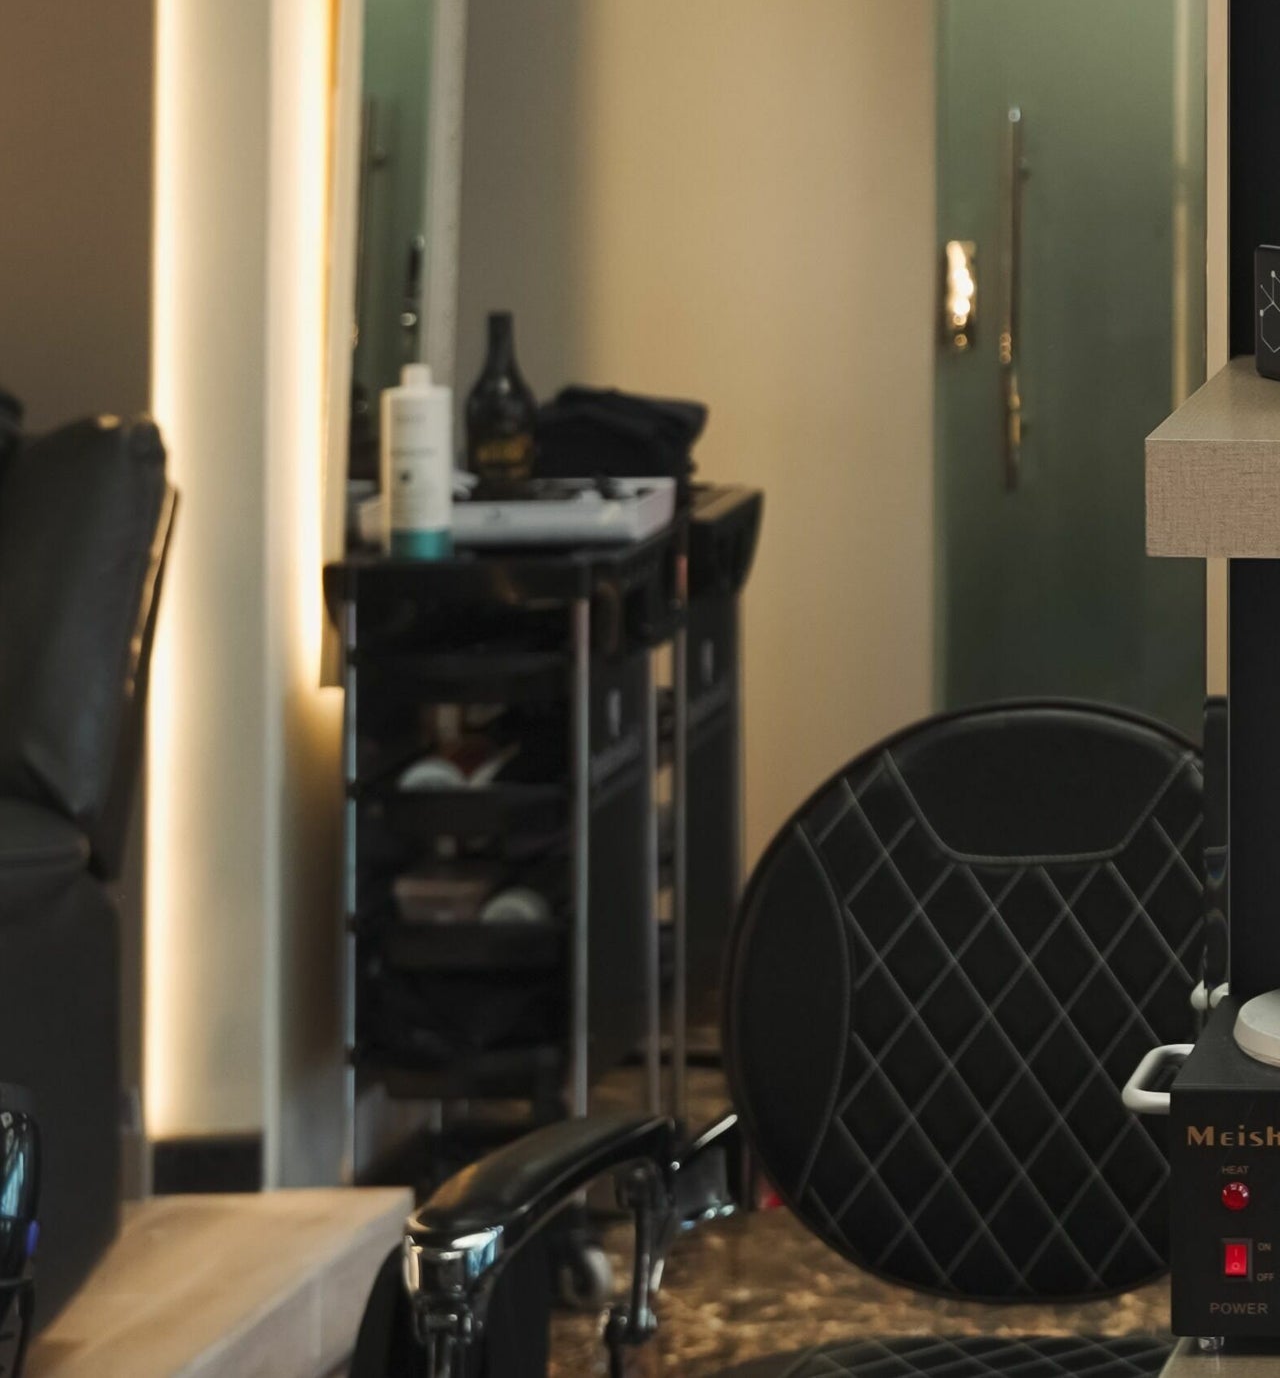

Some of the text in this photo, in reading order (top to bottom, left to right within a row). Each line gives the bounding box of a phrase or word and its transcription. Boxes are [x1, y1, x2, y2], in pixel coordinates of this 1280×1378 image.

[1221, 1165, 1249, 1174] HEAT
[1257, 1242, 1271, 1251] ON
[1256, 1273, 1275, 1282] OFF
[1209, 1302, 1269, 1314] POWER
